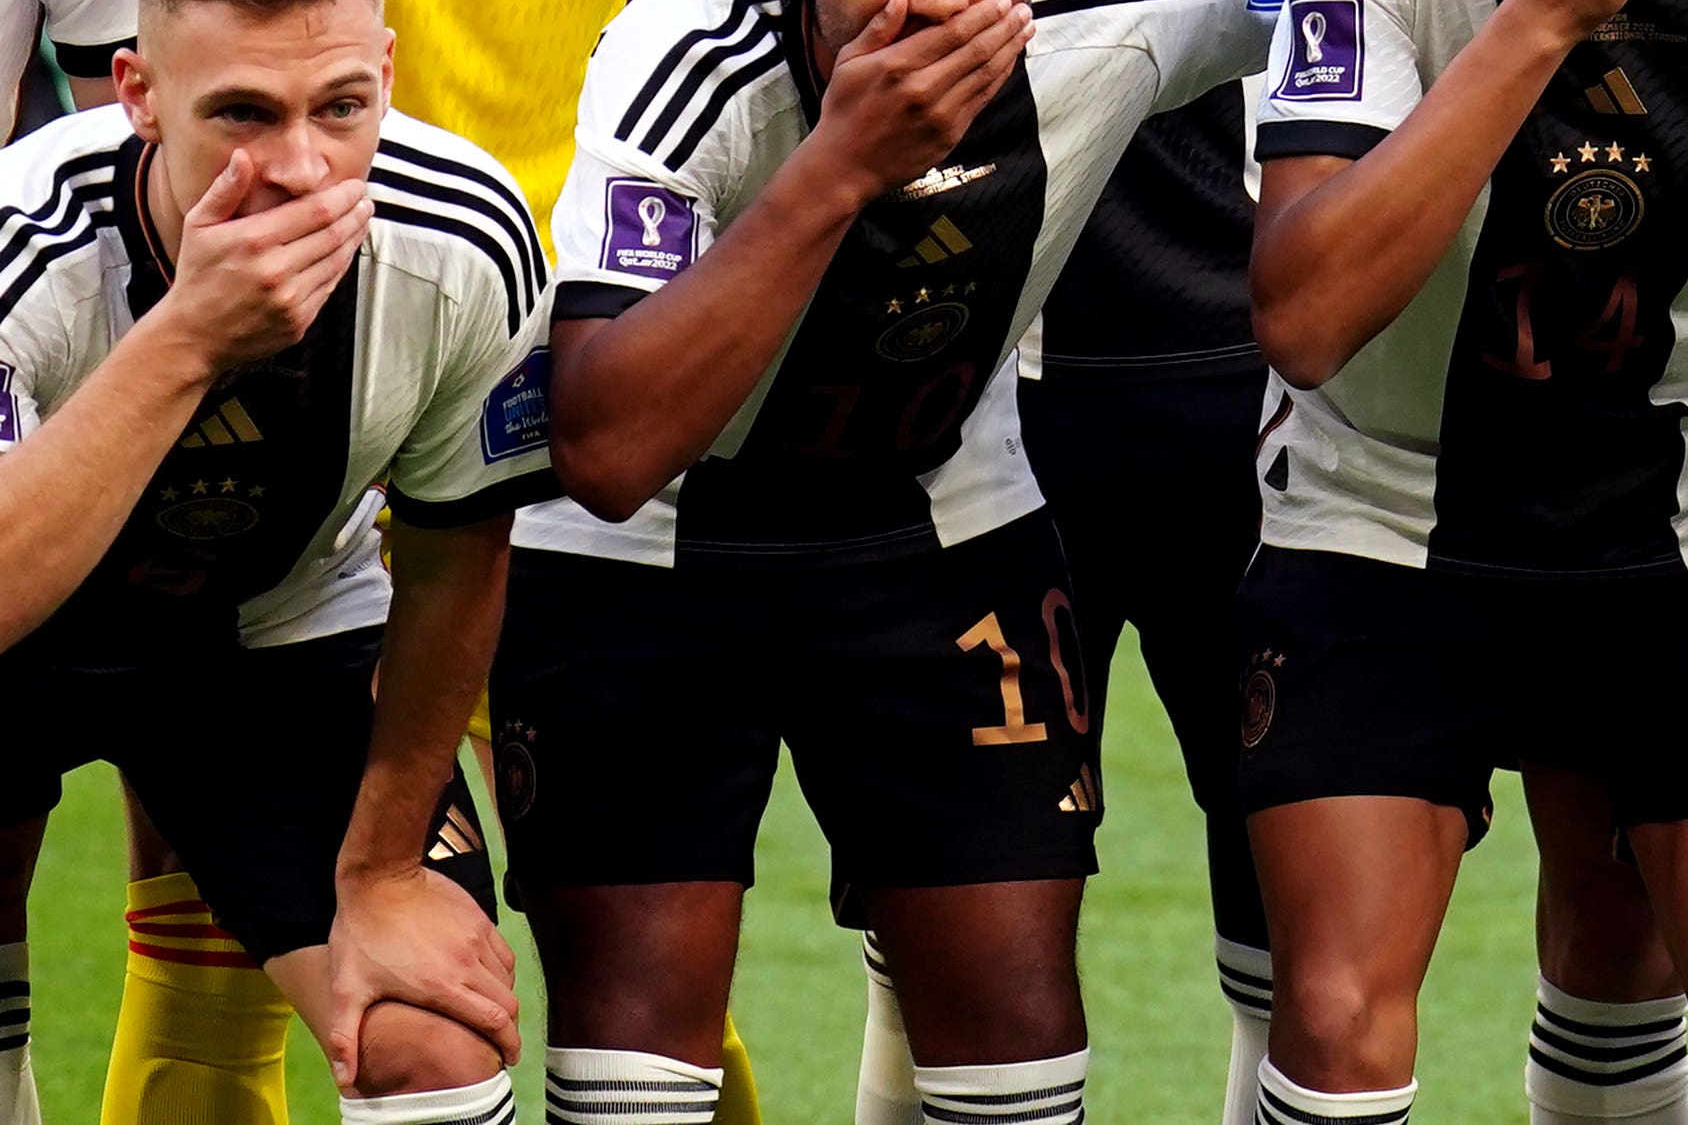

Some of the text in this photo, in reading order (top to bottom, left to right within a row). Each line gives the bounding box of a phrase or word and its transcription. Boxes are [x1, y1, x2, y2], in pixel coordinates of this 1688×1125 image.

[1328, 65, 1346, 75] CUP
[960, 161, 999, 185] STADIUM
[616, 248, 682, 263] FIFA WORLD CUP
[1480, 261, 1647, 382] 14
[503, 386, 545, 411] FOOTBALL
[780, 362, 977, 459] 10
[504, 421, 522, 435] the
[954, 587, 1090, 746] 10
